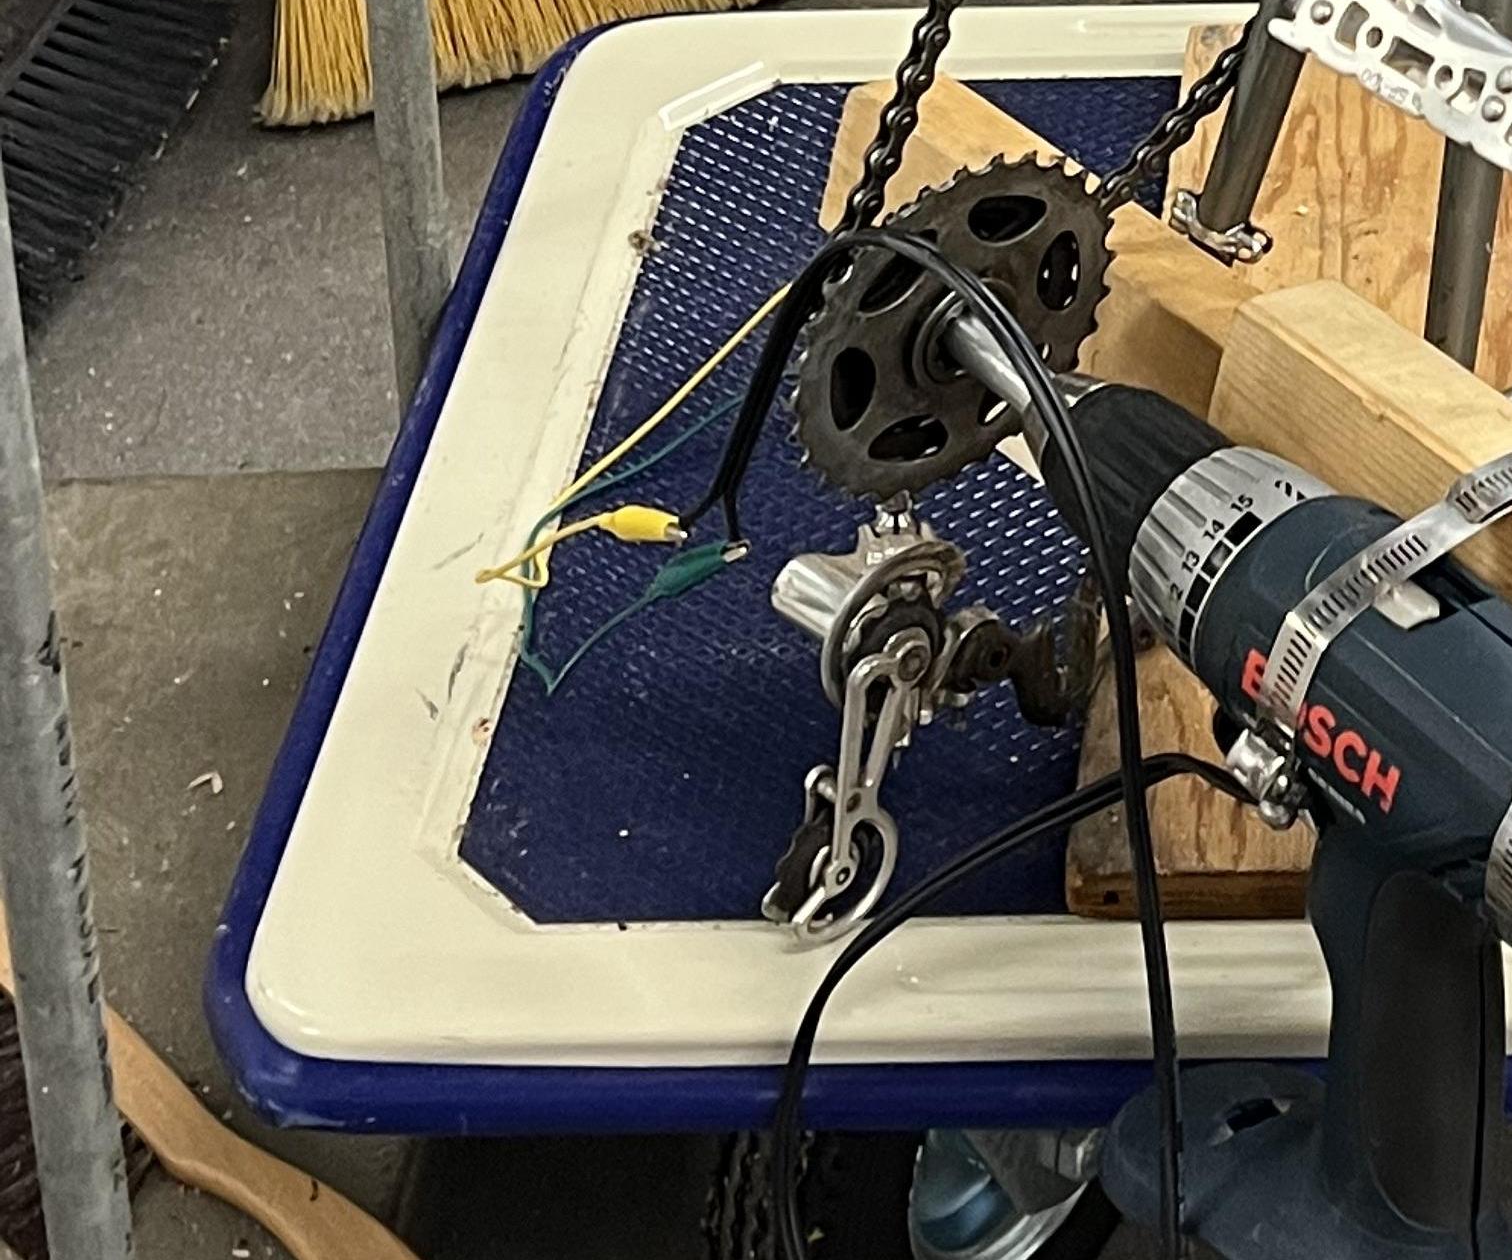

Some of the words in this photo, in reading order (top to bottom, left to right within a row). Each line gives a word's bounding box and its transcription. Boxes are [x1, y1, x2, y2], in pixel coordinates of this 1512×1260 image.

[1181, 550, 1201, 573] 13
[1203, 518, 1225, 541] 14
[1230, 494, 1254, 513] 15
[1241, 646, 1401, 814] BSCH
